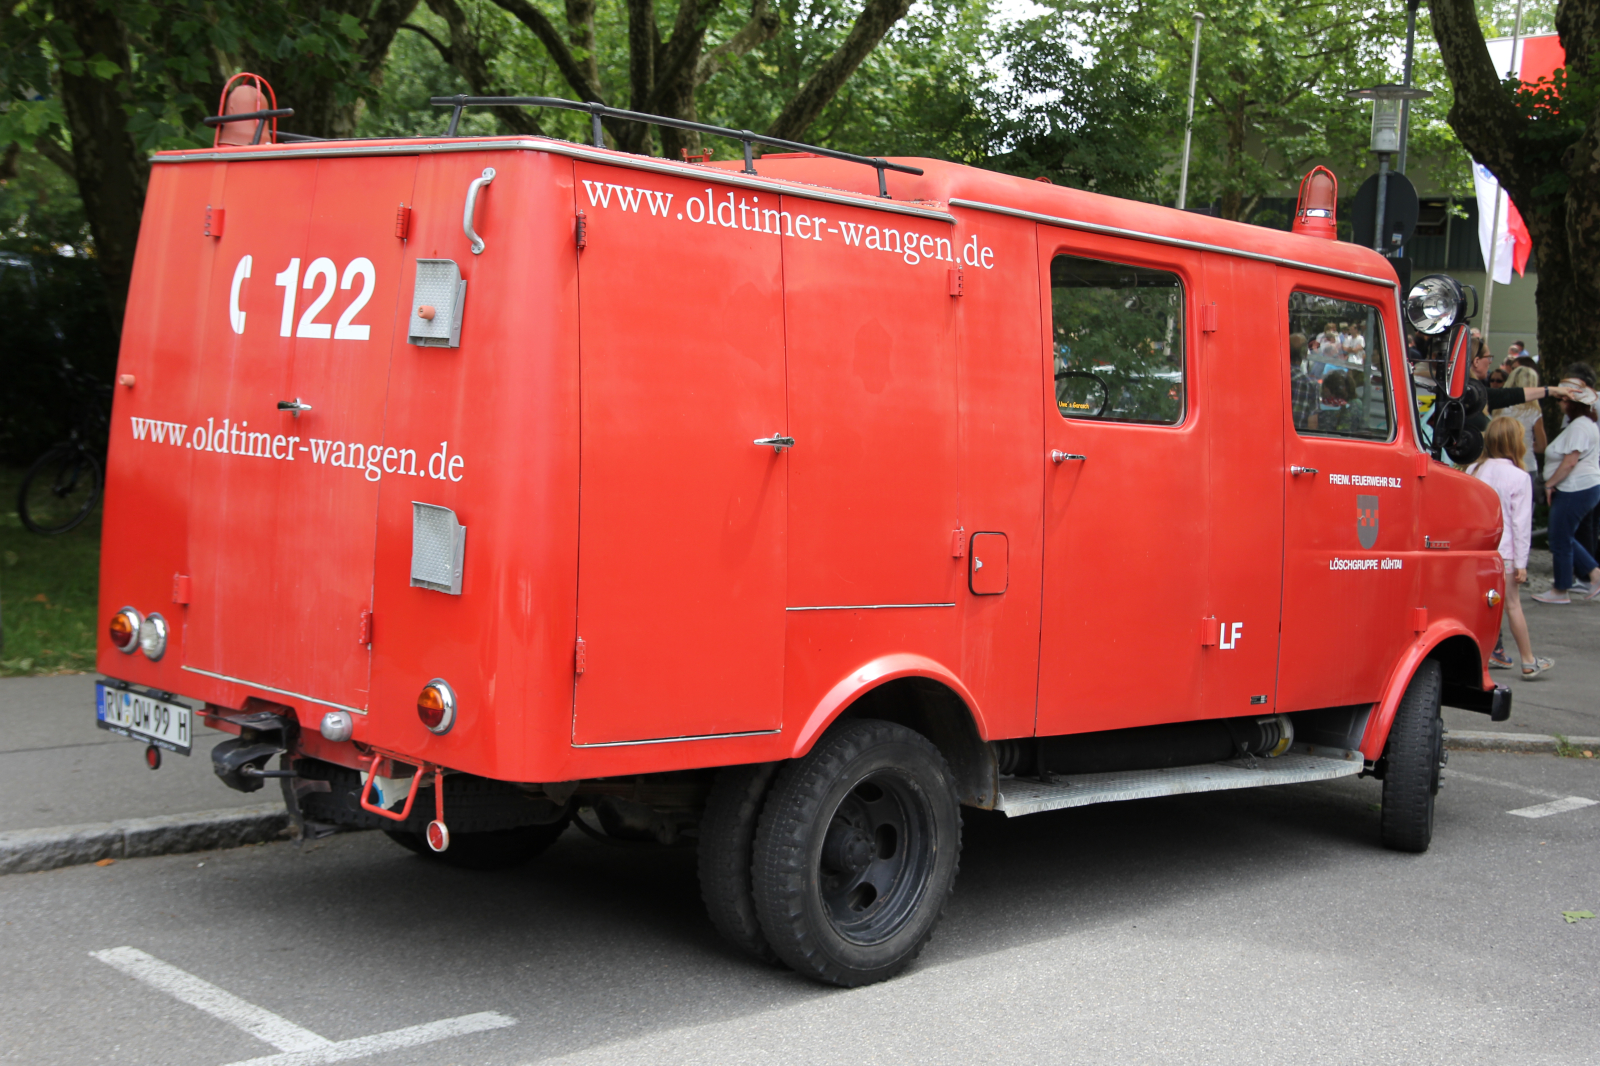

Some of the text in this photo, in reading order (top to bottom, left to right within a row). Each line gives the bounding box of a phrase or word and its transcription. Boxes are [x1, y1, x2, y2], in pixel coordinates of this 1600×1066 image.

[582, 179, 995, 270] www.oldtimer-wangen.de
[275, 256, 376, 341] 122
[130, 416, 465, 483] www.oldtimer-wangen.de
[1351, 474, 1388, 487] FEUERWEHR
[1388, 476, 1402, 489] SILZ
[1329, 557, 1403, 571] LÖSCHGRUPPE KÜHTAI
[1219, 621, 1243, 650] LF
[106, 691, 123, 721] RV
